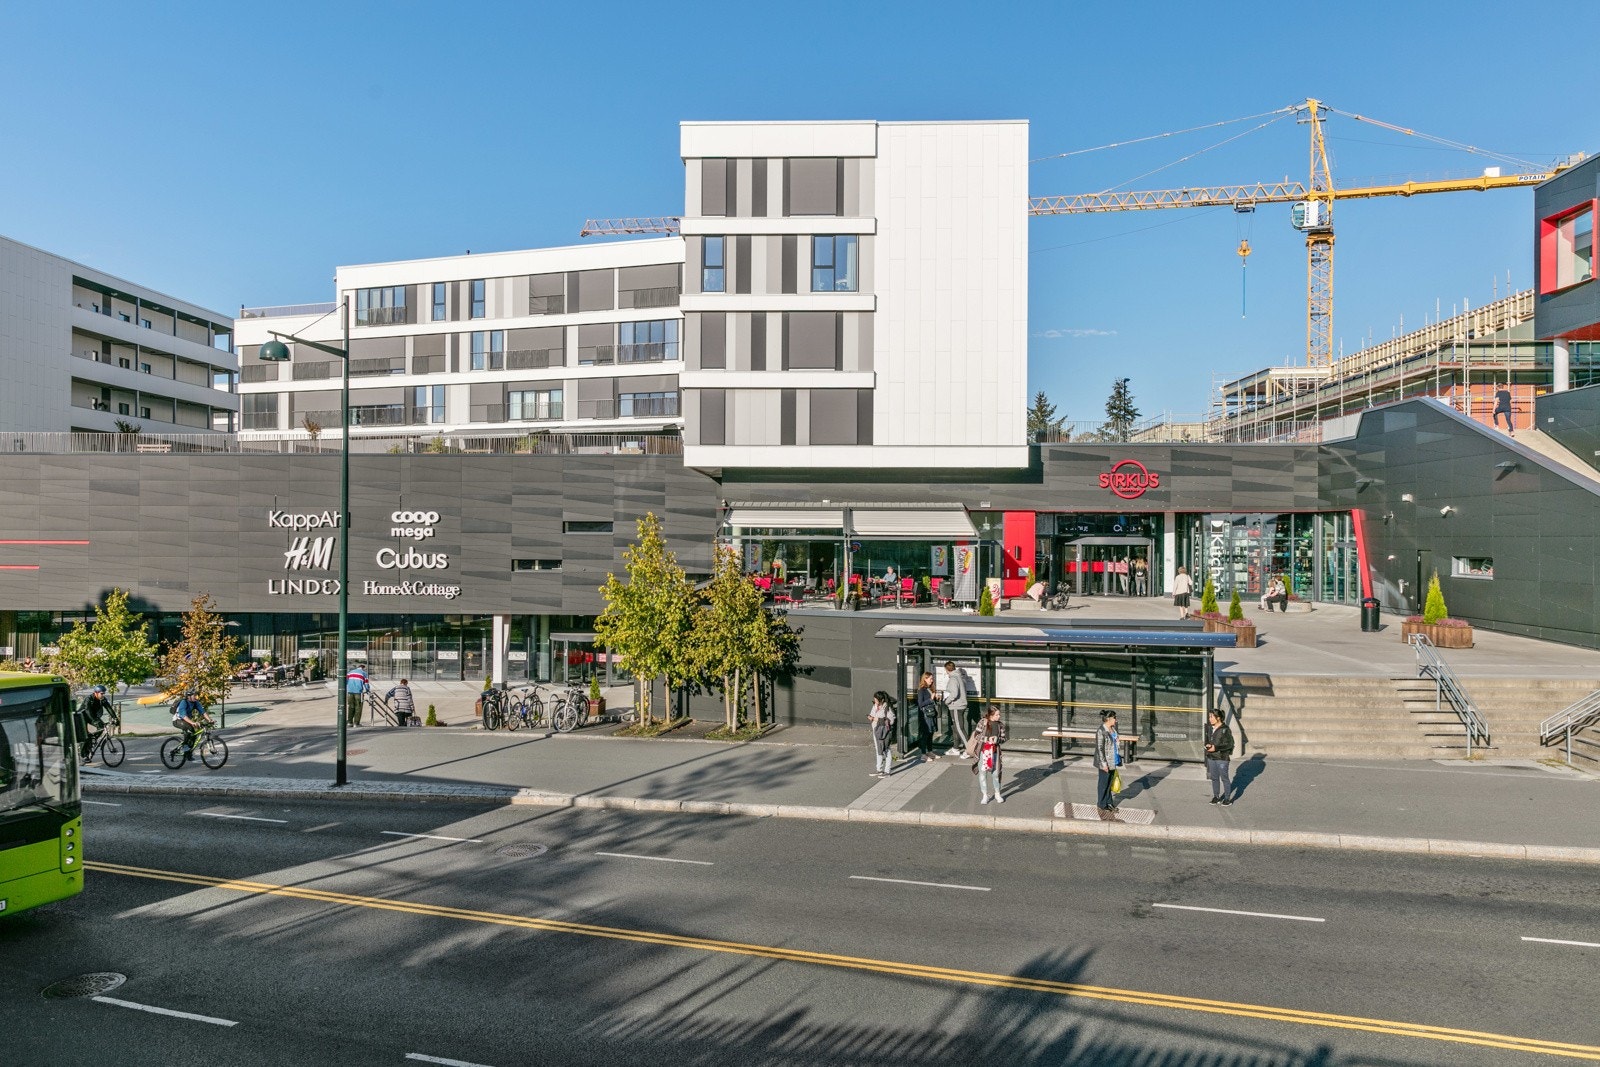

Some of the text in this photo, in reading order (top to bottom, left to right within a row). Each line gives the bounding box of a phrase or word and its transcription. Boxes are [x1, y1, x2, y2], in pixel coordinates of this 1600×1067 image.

[1099, 472, 1160, 488] SIRKUS
[269, 510, 342, 531] KappAh
[391, 510, 440, 526] coop
[391, 527, 434, 541] mega
[284, 536, 336, 571] H&M
[376, 547, 449, 569] Cubus
